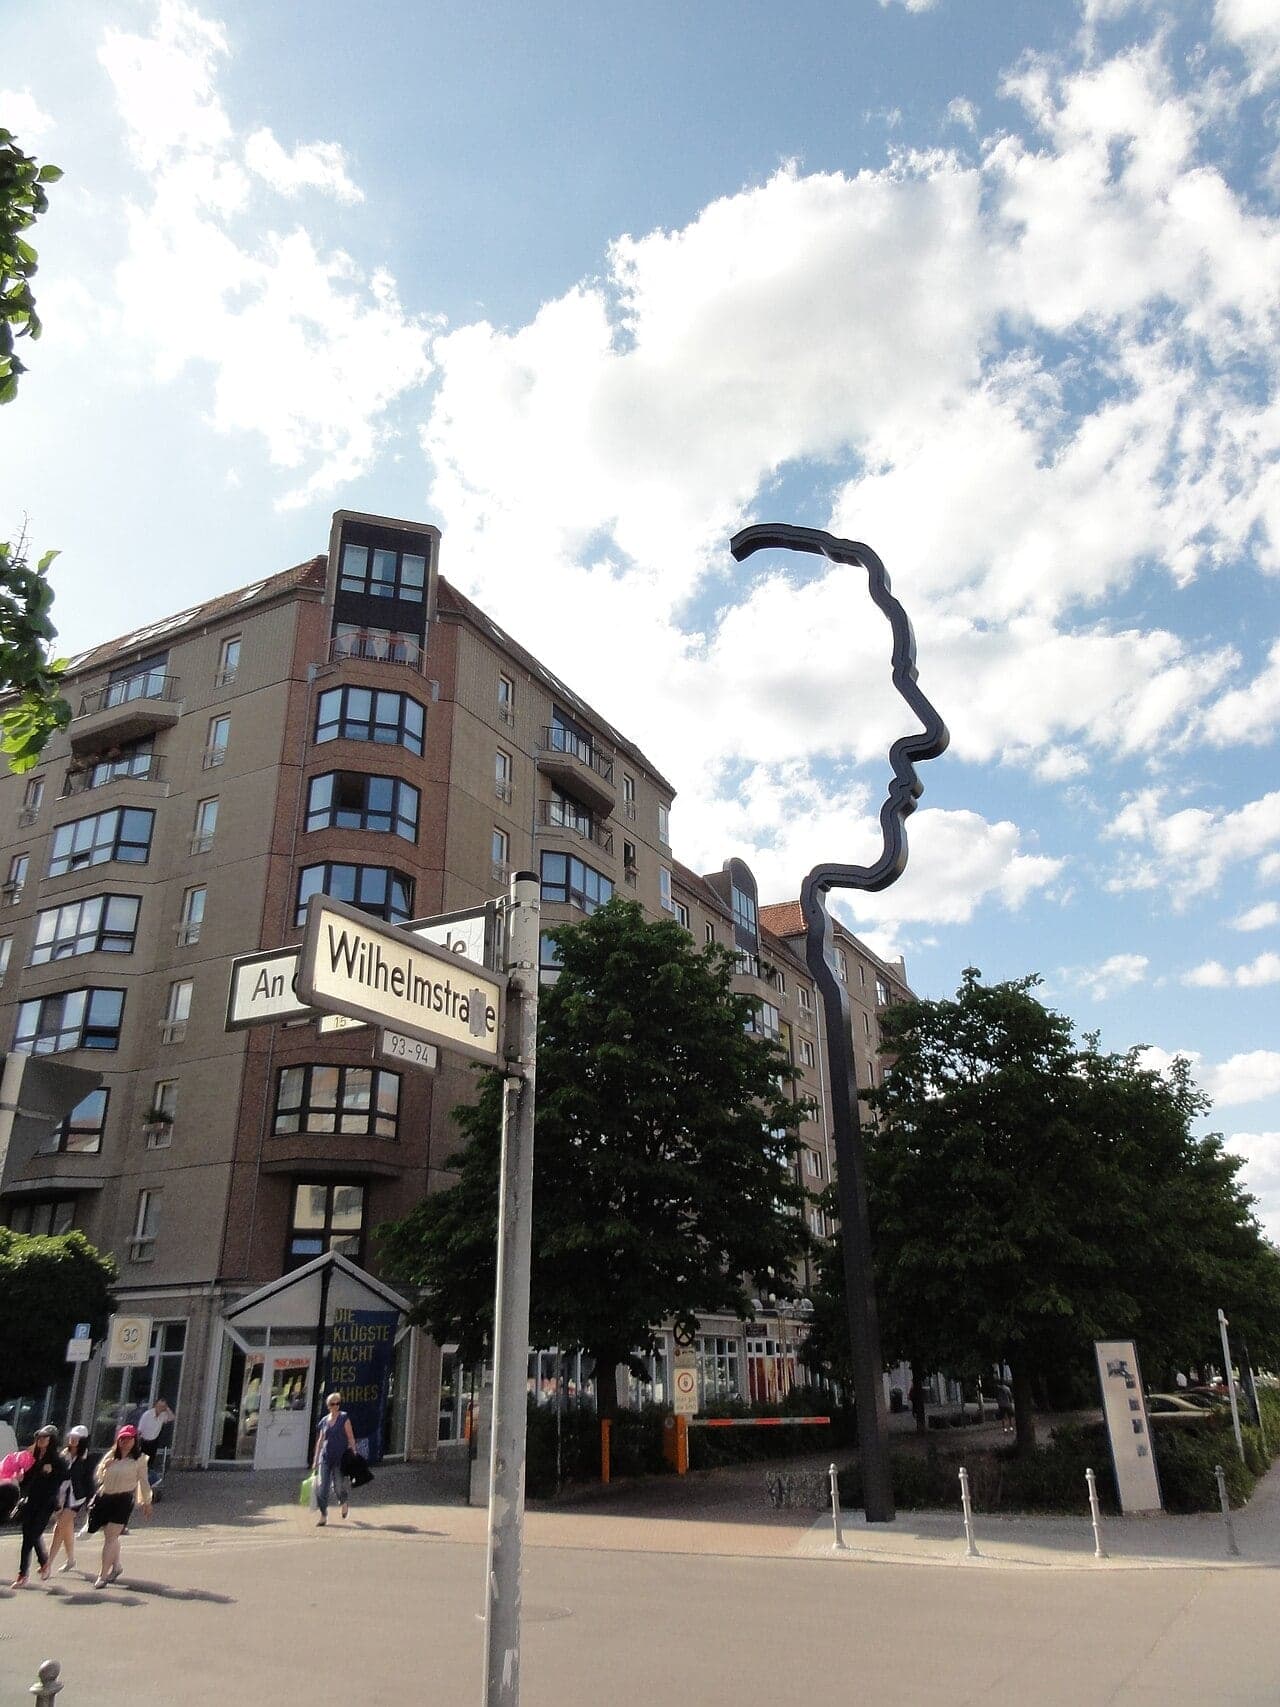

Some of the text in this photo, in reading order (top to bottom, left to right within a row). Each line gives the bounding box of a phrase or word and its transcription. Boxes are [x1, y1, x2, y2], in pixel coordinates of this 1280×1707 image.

[251, 968, 285, 1002] An
[327, 924, 496, 1036] Wilhelmstrae
[335, 1308, 355, 1323] DIE
[333, 1324, 390, 1342] KLÜGSTE
[332, 1345, 374, 1362] NACHT
[331, 1366, 356, 1383] DES
